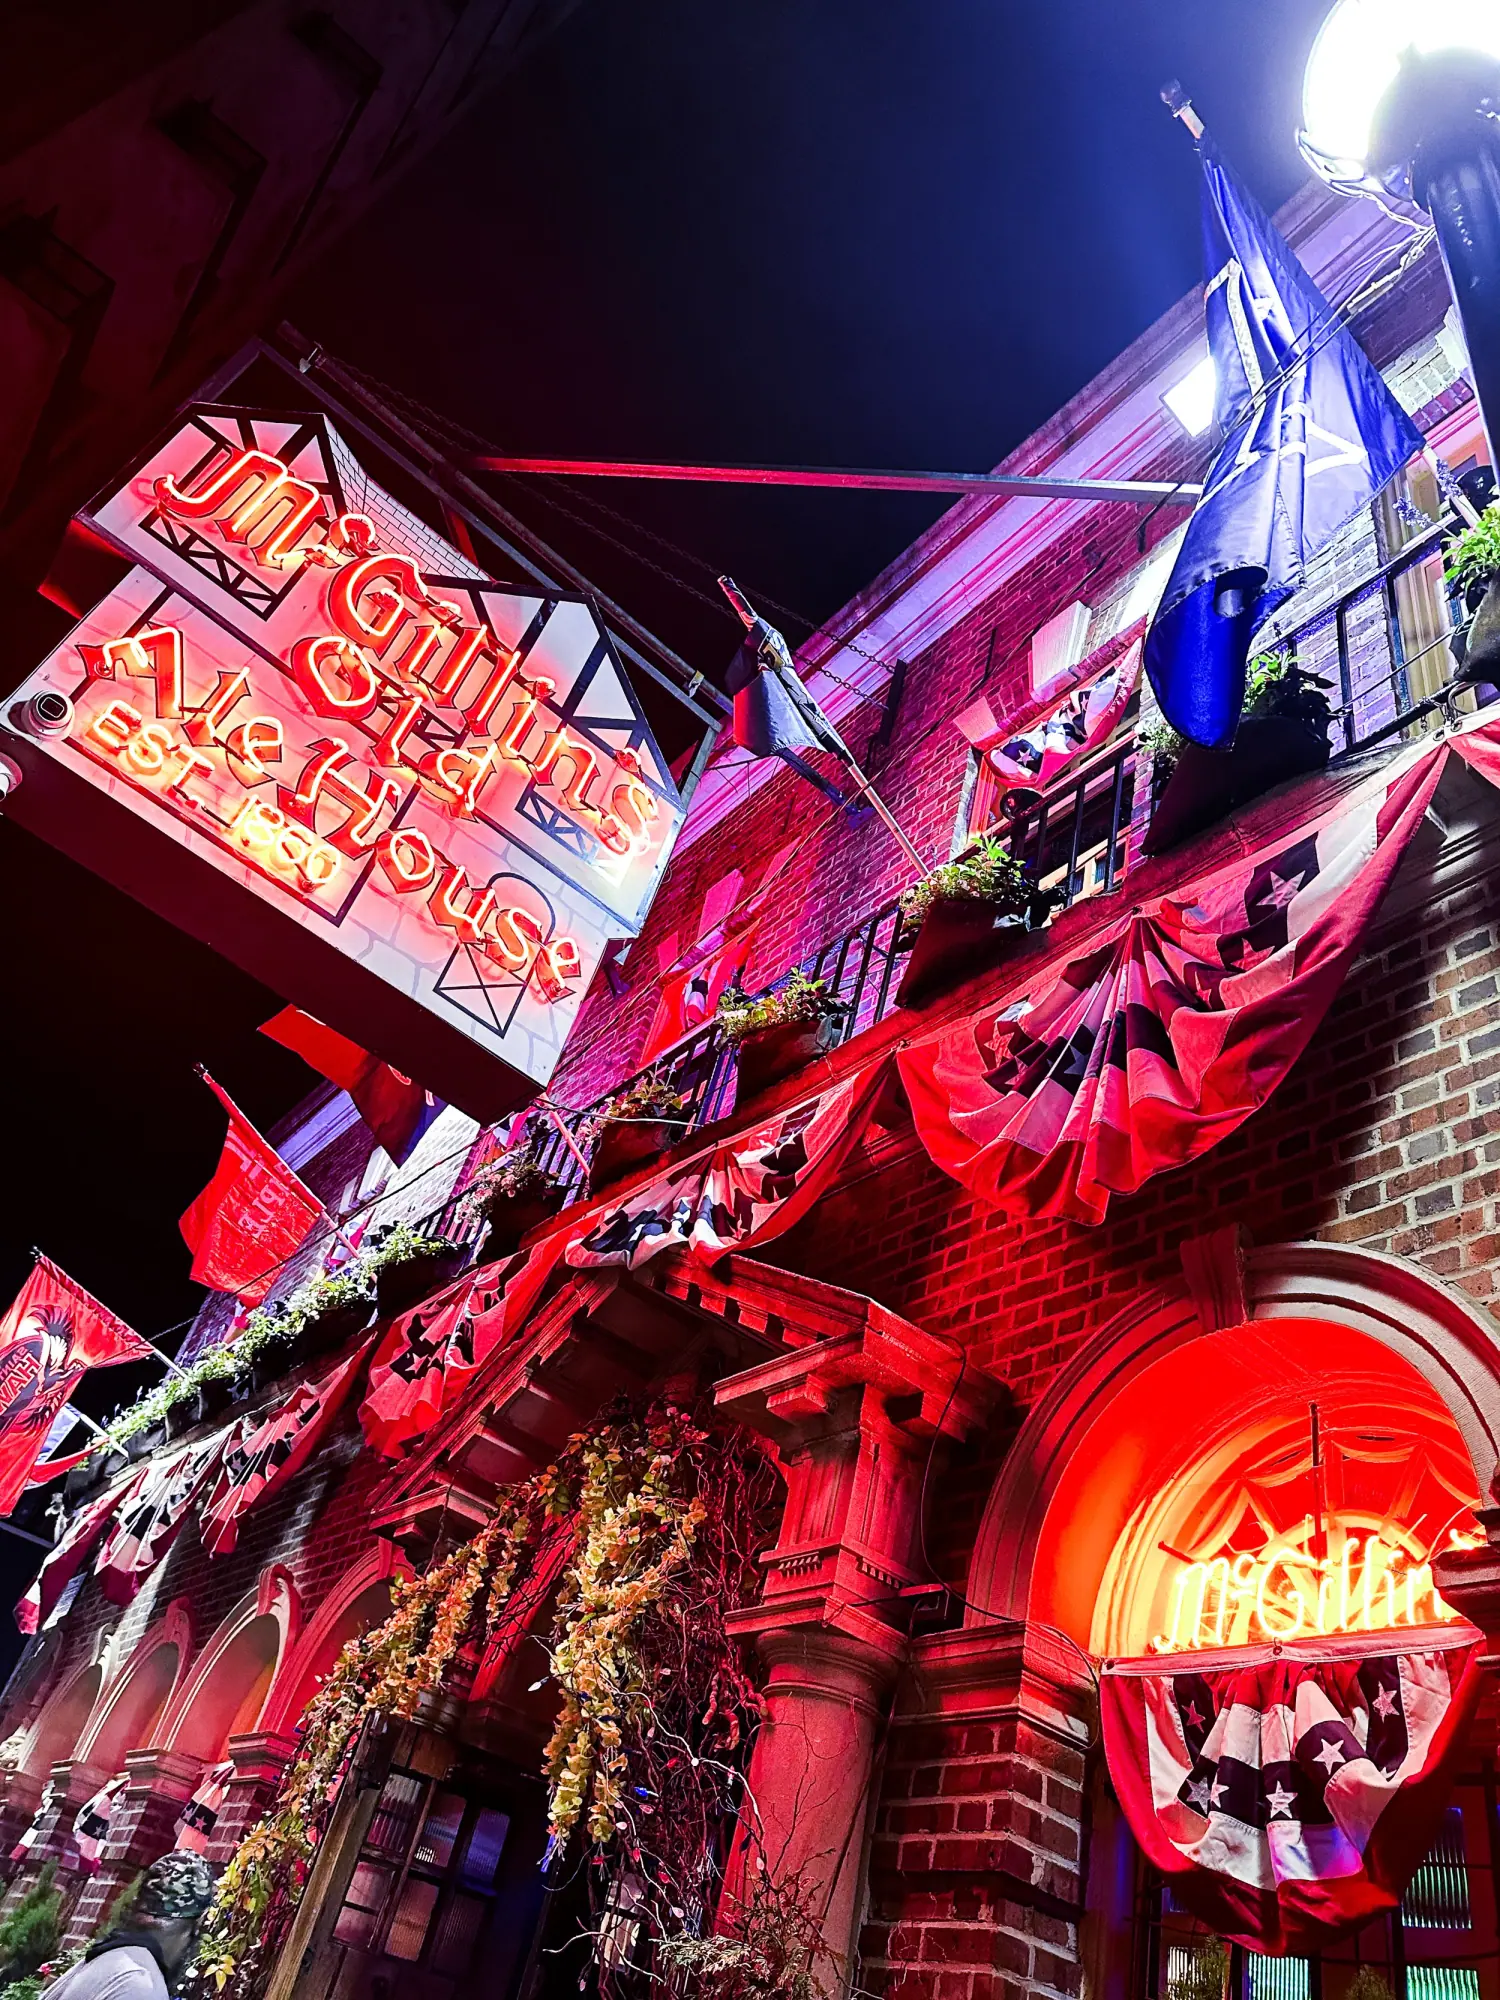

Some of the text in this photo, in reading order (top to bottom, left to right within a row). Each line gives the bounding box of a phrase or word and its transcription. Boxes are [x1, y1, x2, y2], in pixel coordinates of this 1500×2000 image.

[75, 621, 582, 1004] Ale House
[226, 794, 342, 886] 1860
[1153, 1529, 1476, 1650] McGillin
